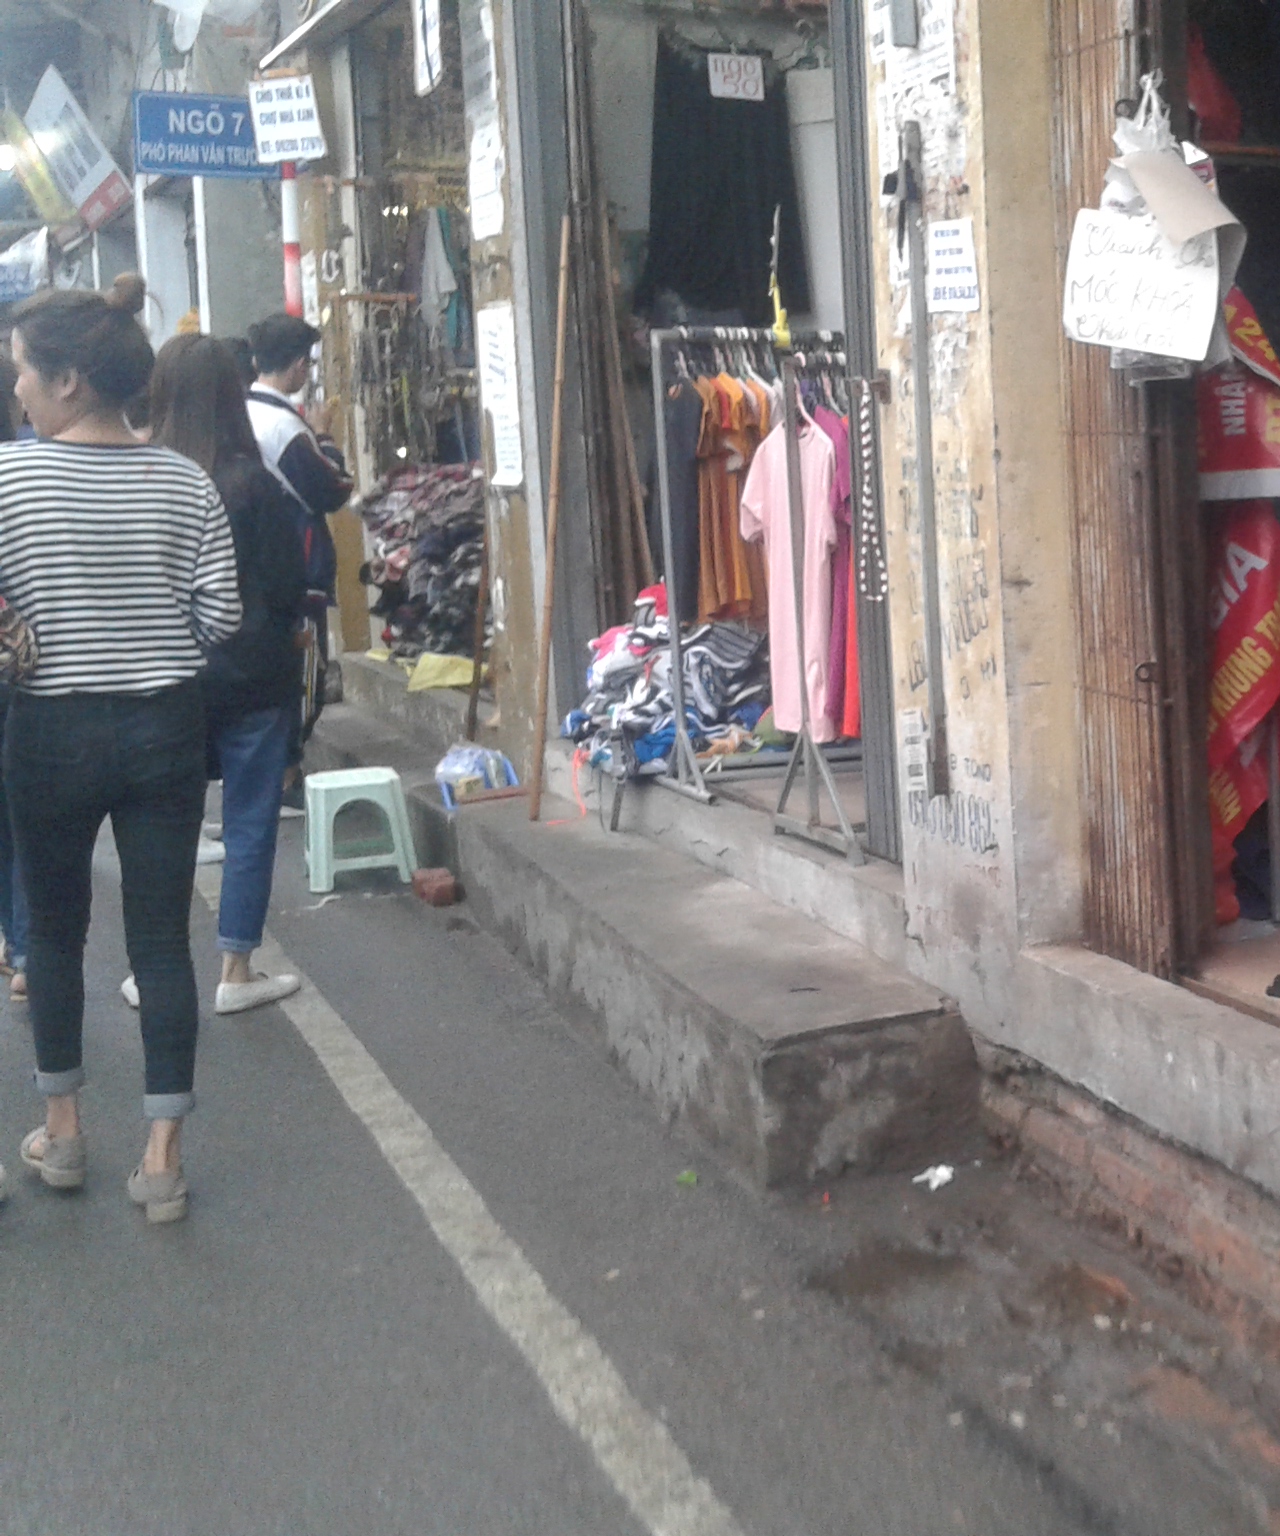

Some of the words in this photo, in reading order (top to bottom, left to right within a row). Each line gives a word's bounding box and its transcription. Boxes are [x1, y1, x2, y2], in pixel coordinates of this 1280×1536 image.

[168, 104, 225, 136] NGÕ
[231, 112, 245, 136] 7
[140, 136, 166, 163] PHỐ
[168, 142, 199, 163] PHAN
